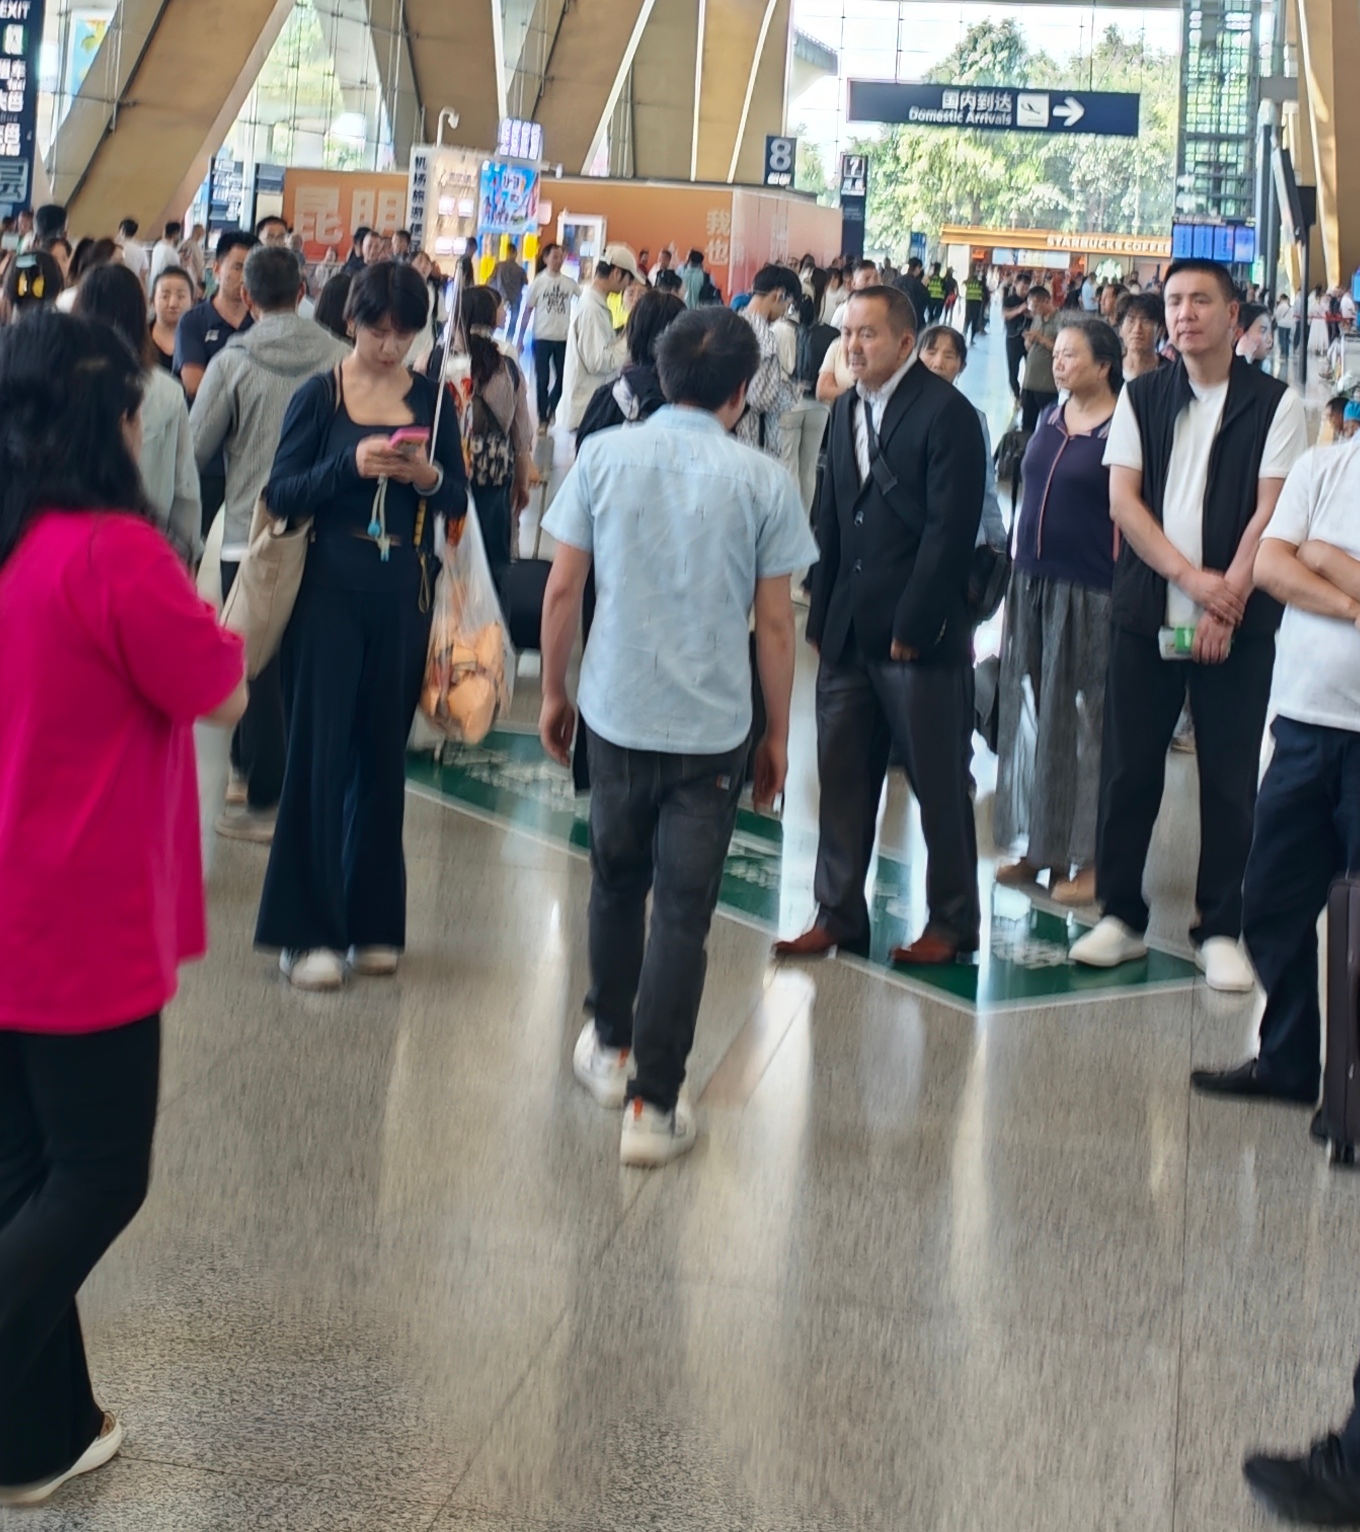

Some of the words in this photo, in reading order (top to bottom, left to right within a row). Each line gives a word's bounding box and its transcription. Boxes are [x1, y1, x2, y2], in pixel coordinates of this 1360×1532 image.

[942, 89, 1012, 112] 国内到达
[909, 105, 963, 123] Domestic
[965, 109, 1012, 126] Arrivals
[769, 138, 791, 171] 8
[1046, 233, 1122, 251] STARBUCKS
